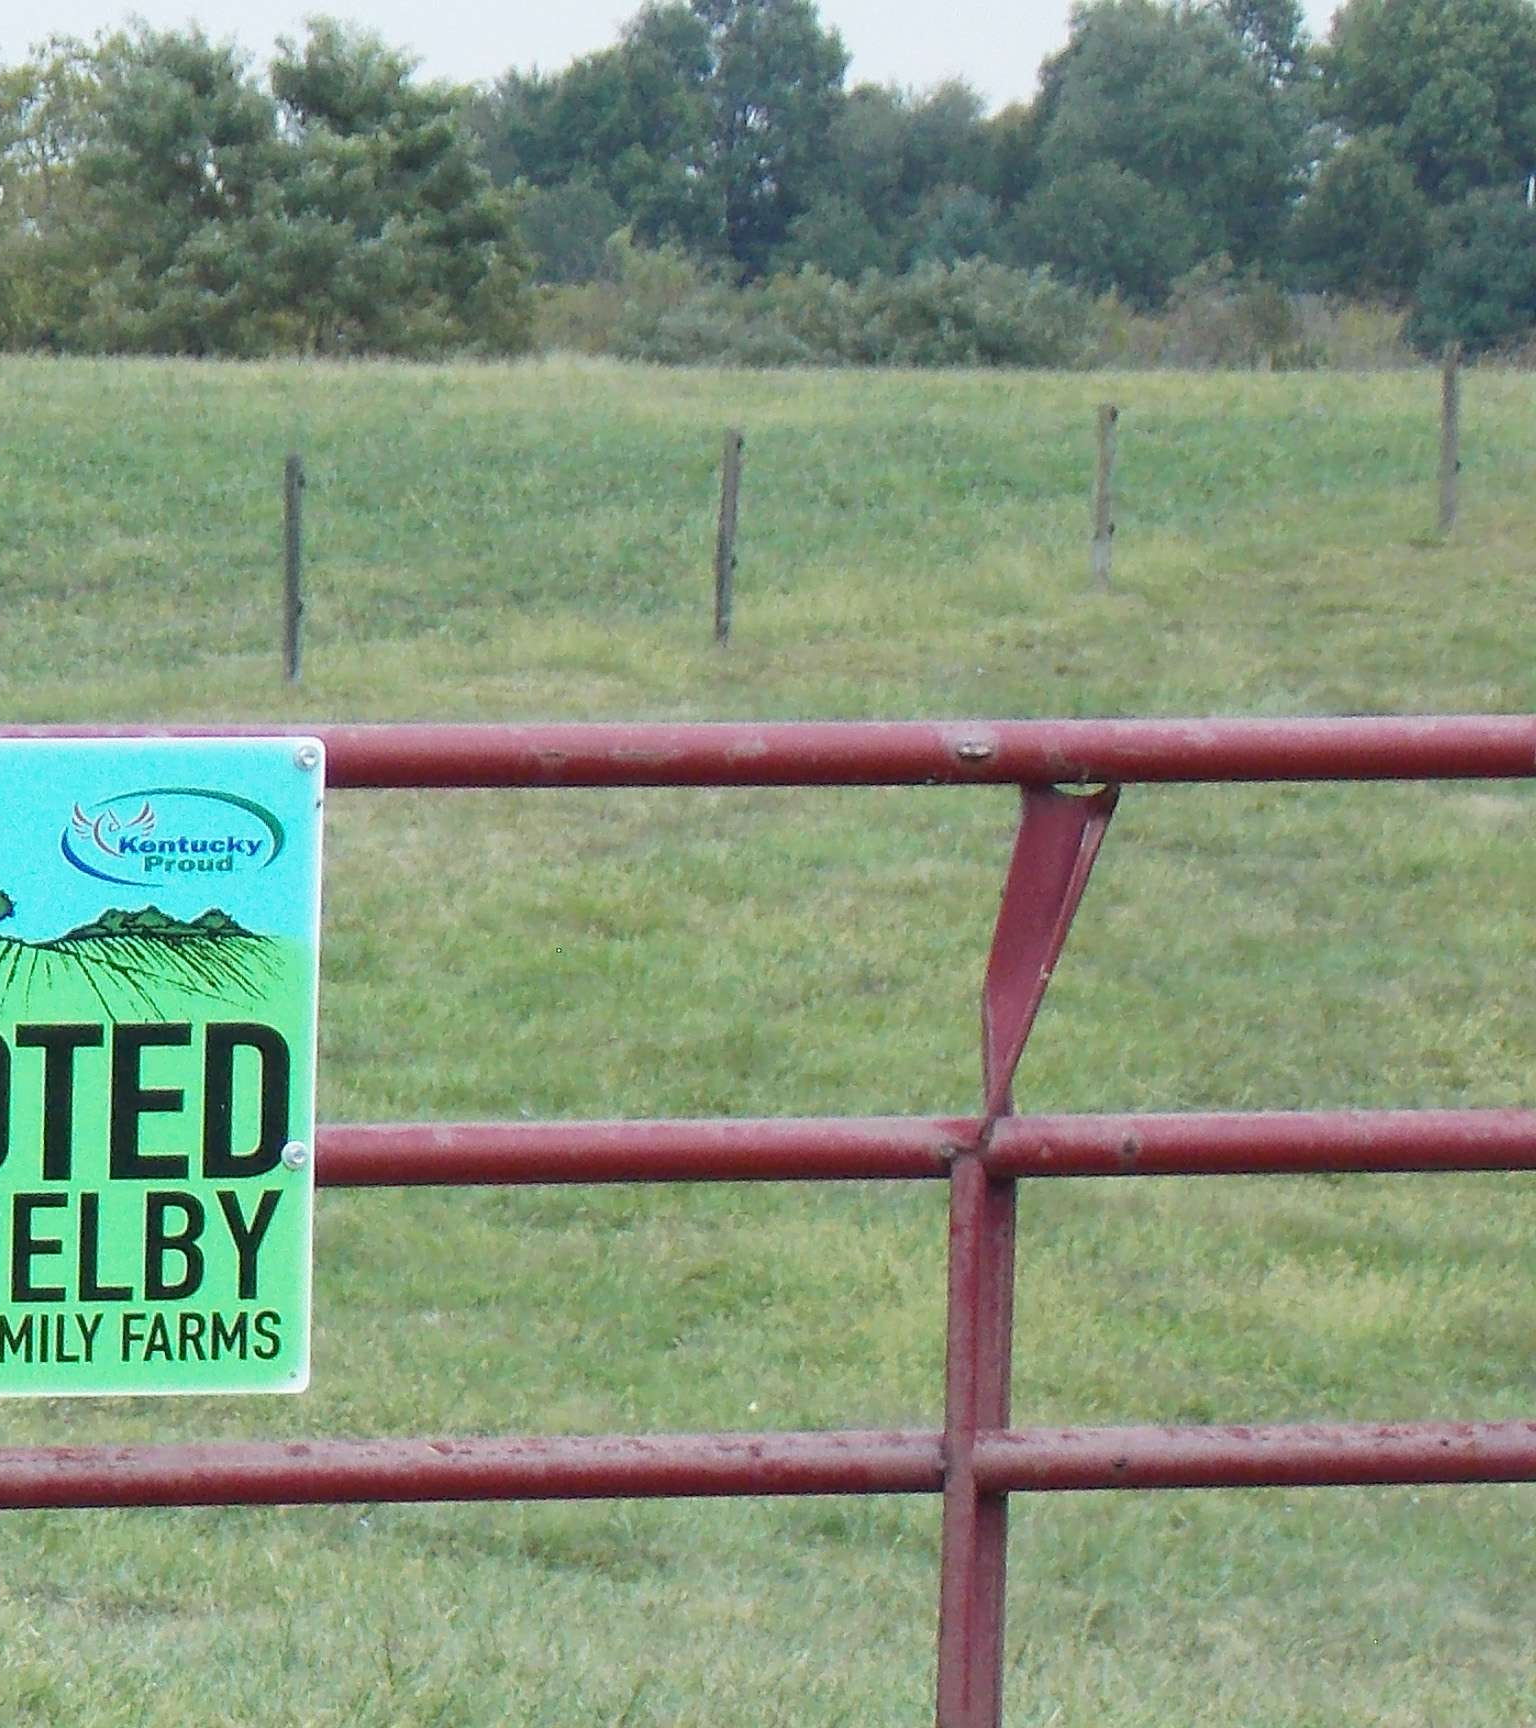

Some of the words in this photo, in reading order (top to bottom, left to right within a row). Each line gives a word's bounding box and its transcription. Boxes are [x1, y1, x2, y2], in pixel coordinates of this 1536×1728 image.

[118, 836, 263, 856] Kentucky
[143, 855, 233, 872] Proud
[127, 1311, 282, 1361] FARMS
